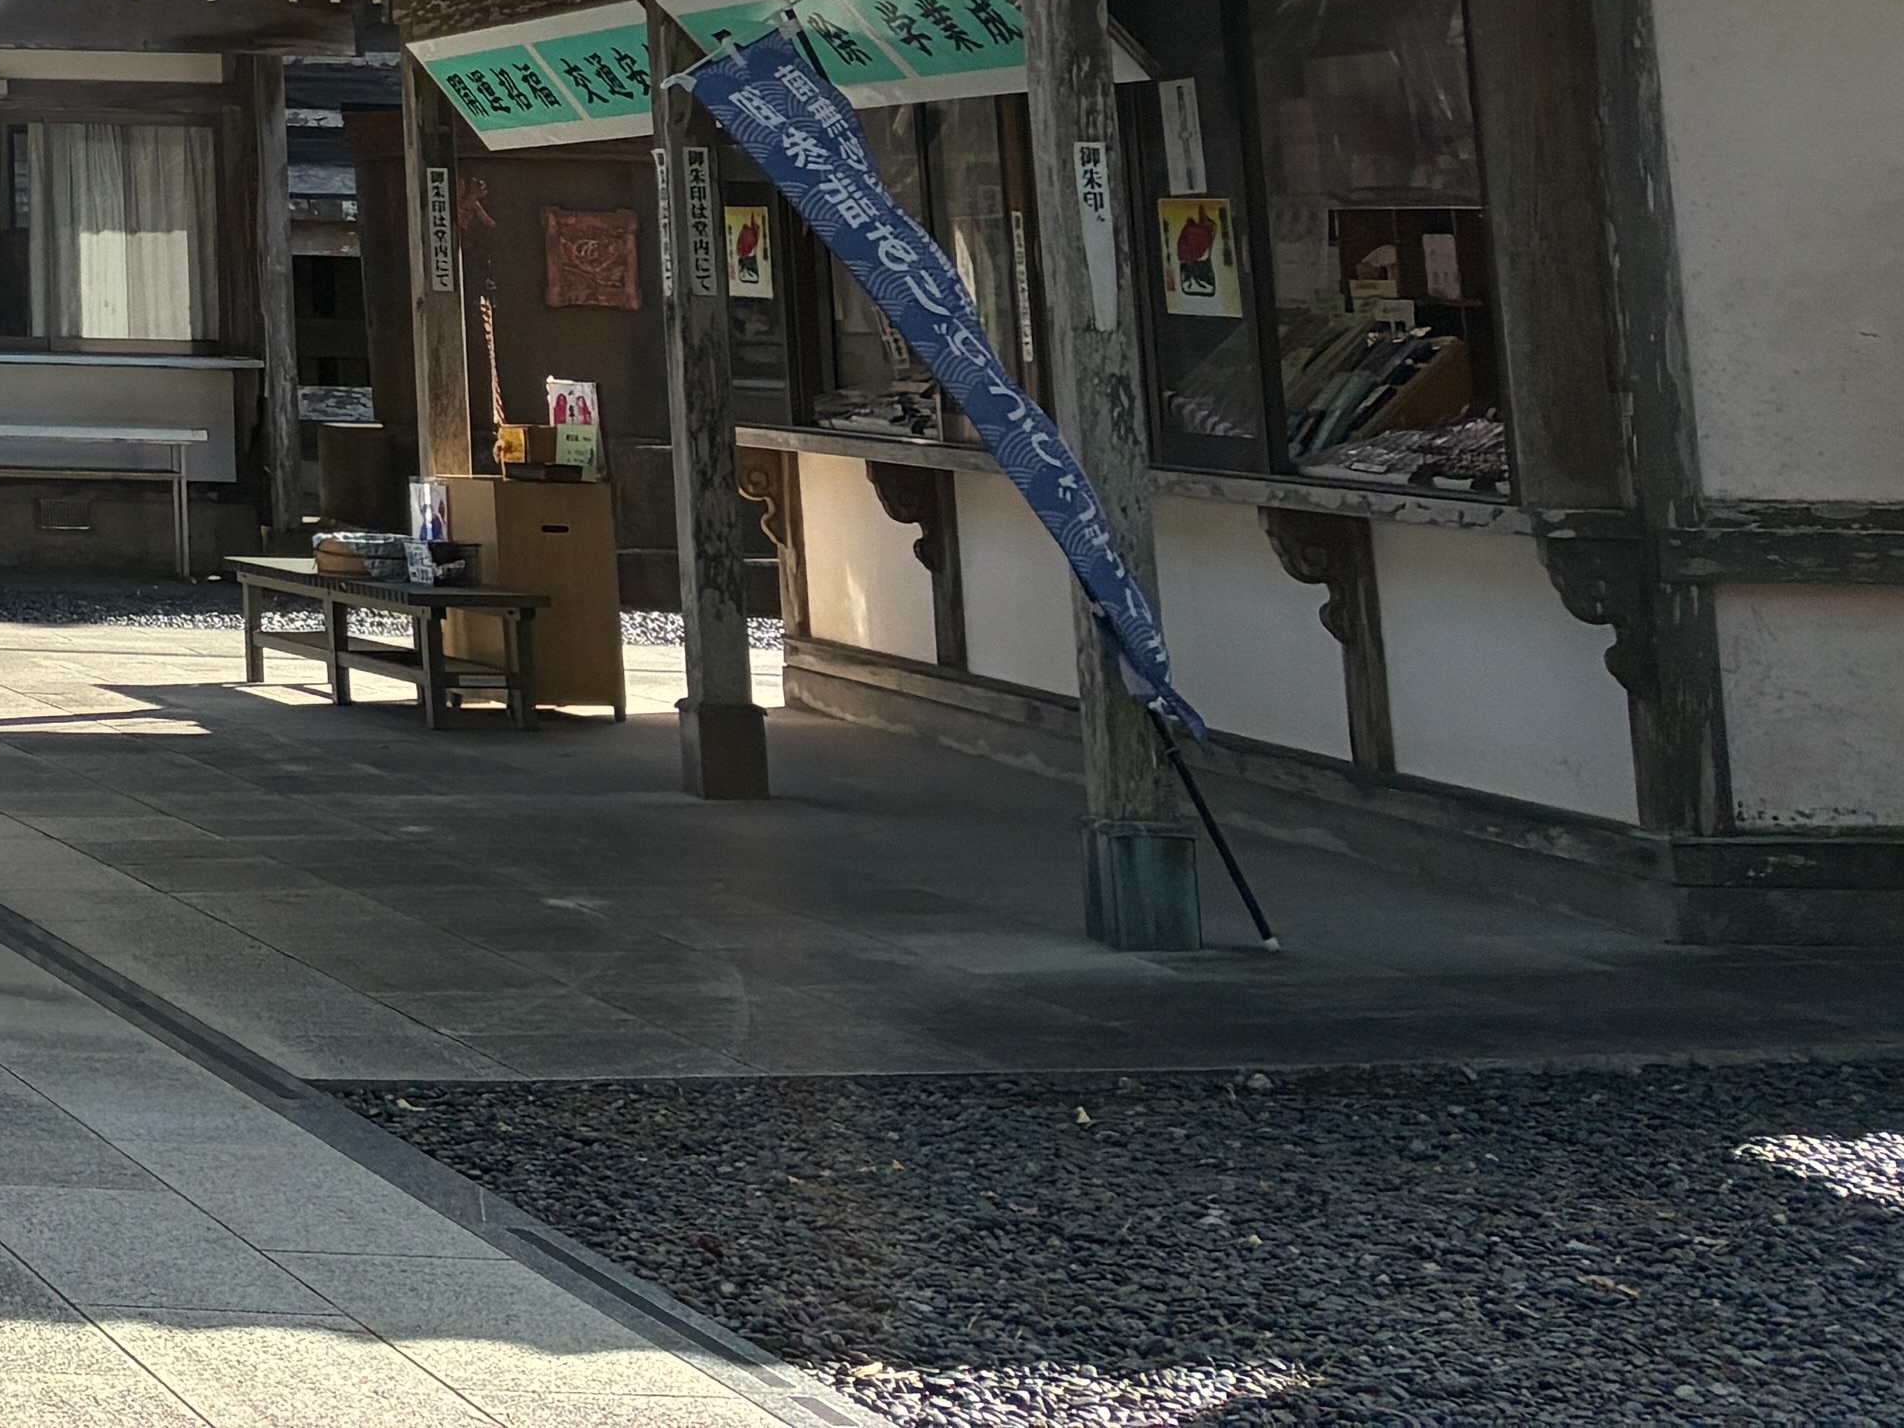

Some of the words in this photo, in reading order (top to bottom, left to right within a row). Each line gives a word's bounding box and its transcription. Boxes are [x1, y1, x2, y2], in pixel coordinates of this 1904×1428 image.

[446, 63, 562, 118] 開運招福
[560, 43, 651, 104] 交通安
